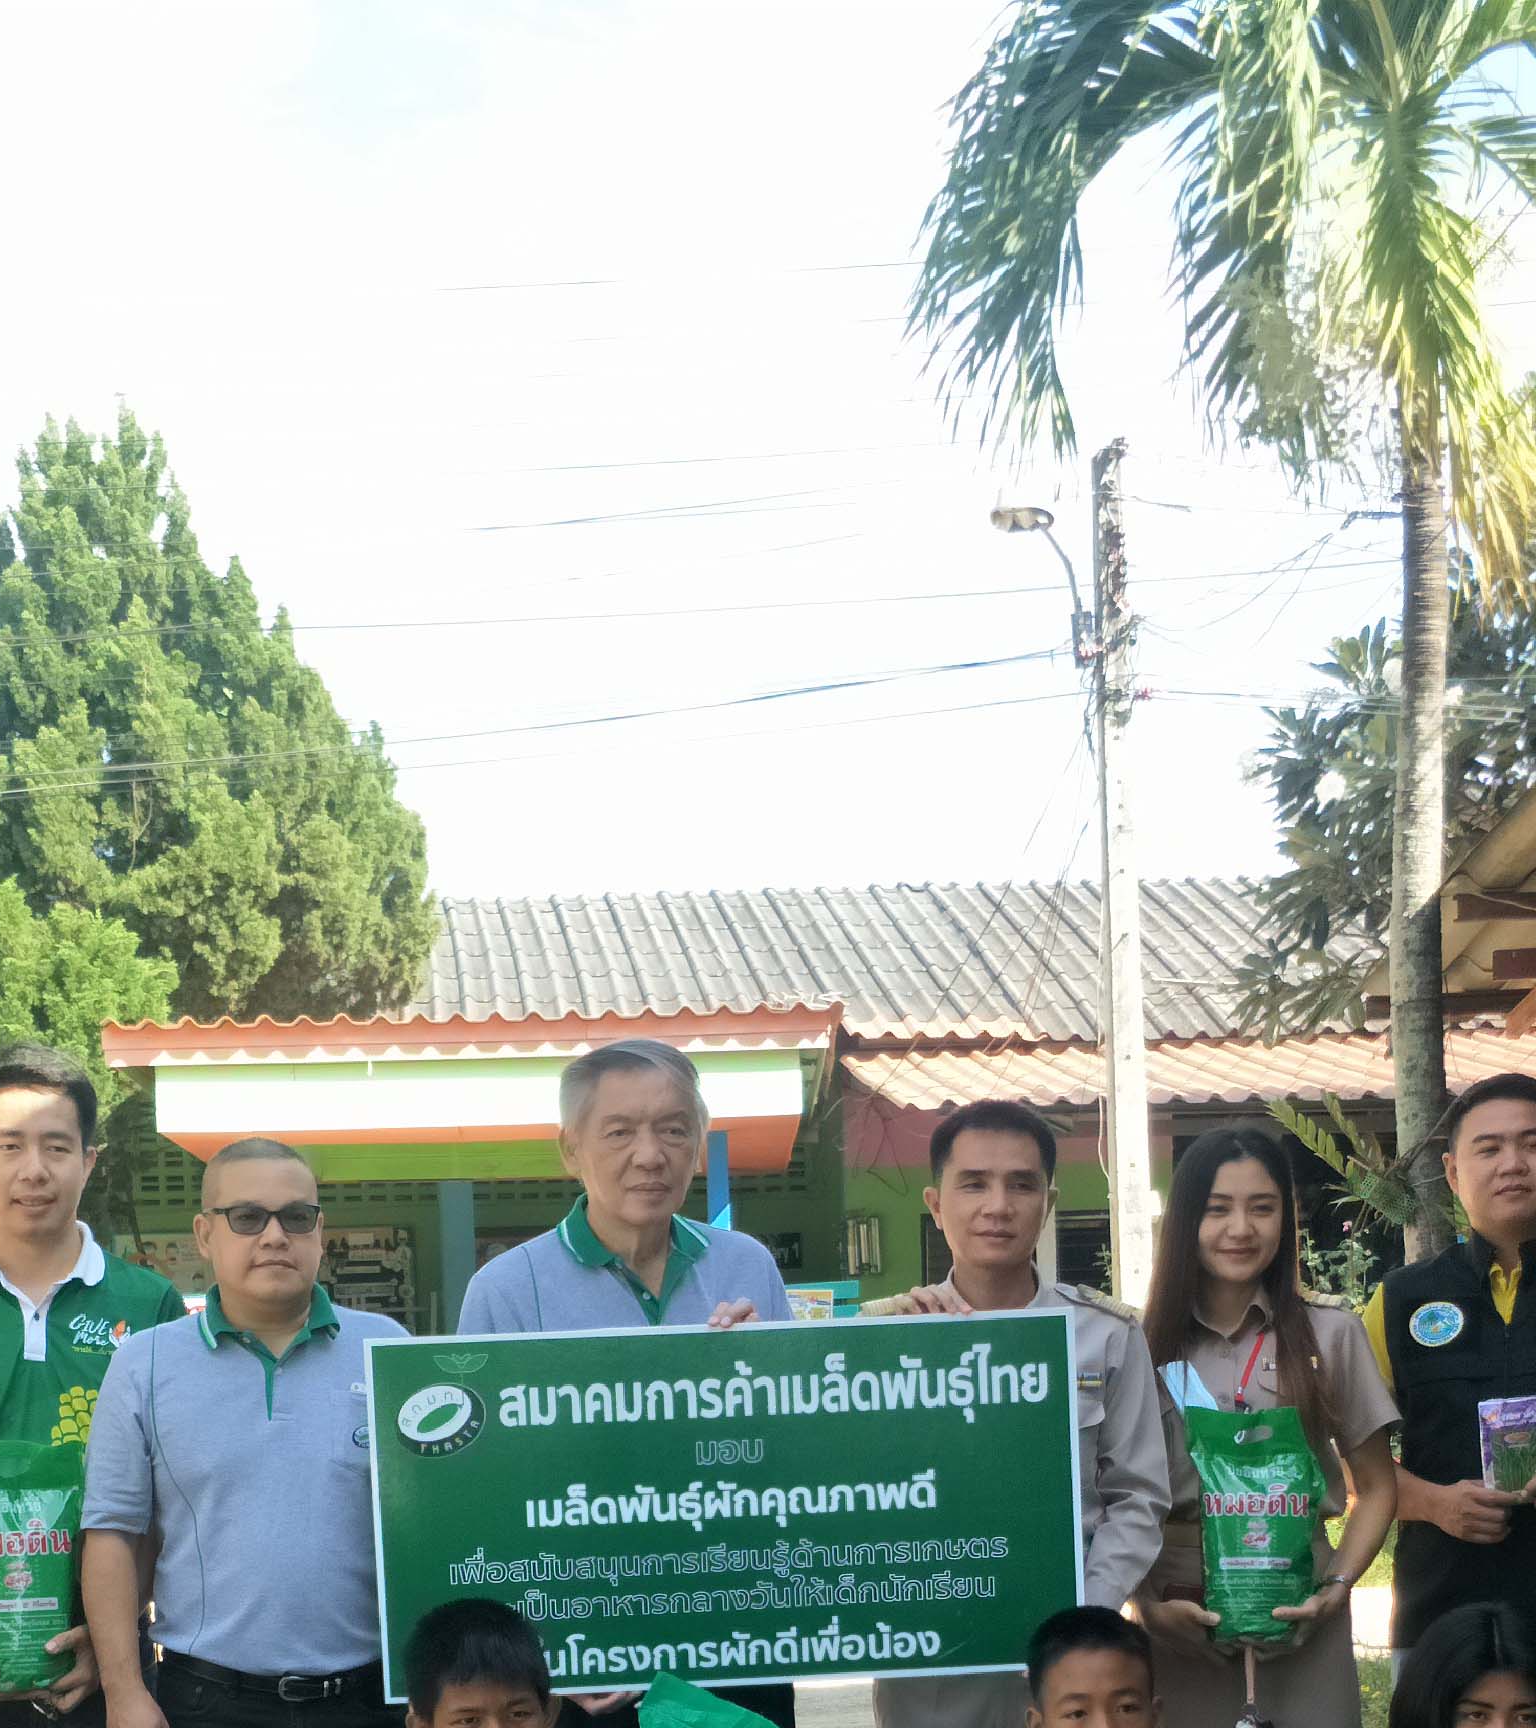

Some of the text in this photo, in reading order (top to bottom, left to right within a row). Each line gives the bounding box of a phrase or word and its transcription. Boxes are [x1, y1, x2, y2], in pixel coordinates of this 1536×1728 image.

[499, 1343, 1048, 1427] สมาคมการค้าเมล็ดพันธุ์ไทย
[696, 1439, 764, 1466] มอบ
[526, 1468, 937, 1531] เมล็ดพันธุ์ผักคุณภาพดี
[1202, 1482, 1310, 1518] หมอดิน
[449, 1537, 1009, 1586] เพื่อสนับสนุนการเรียนรู้ด้านการเกษตร
[507, 1571, 996, 1622] เป็นอาหารกลางวันให้เด็กนักเรียน
[541, 1615, 941, 1677] นโครงการผักดีเพื่อน้อง
